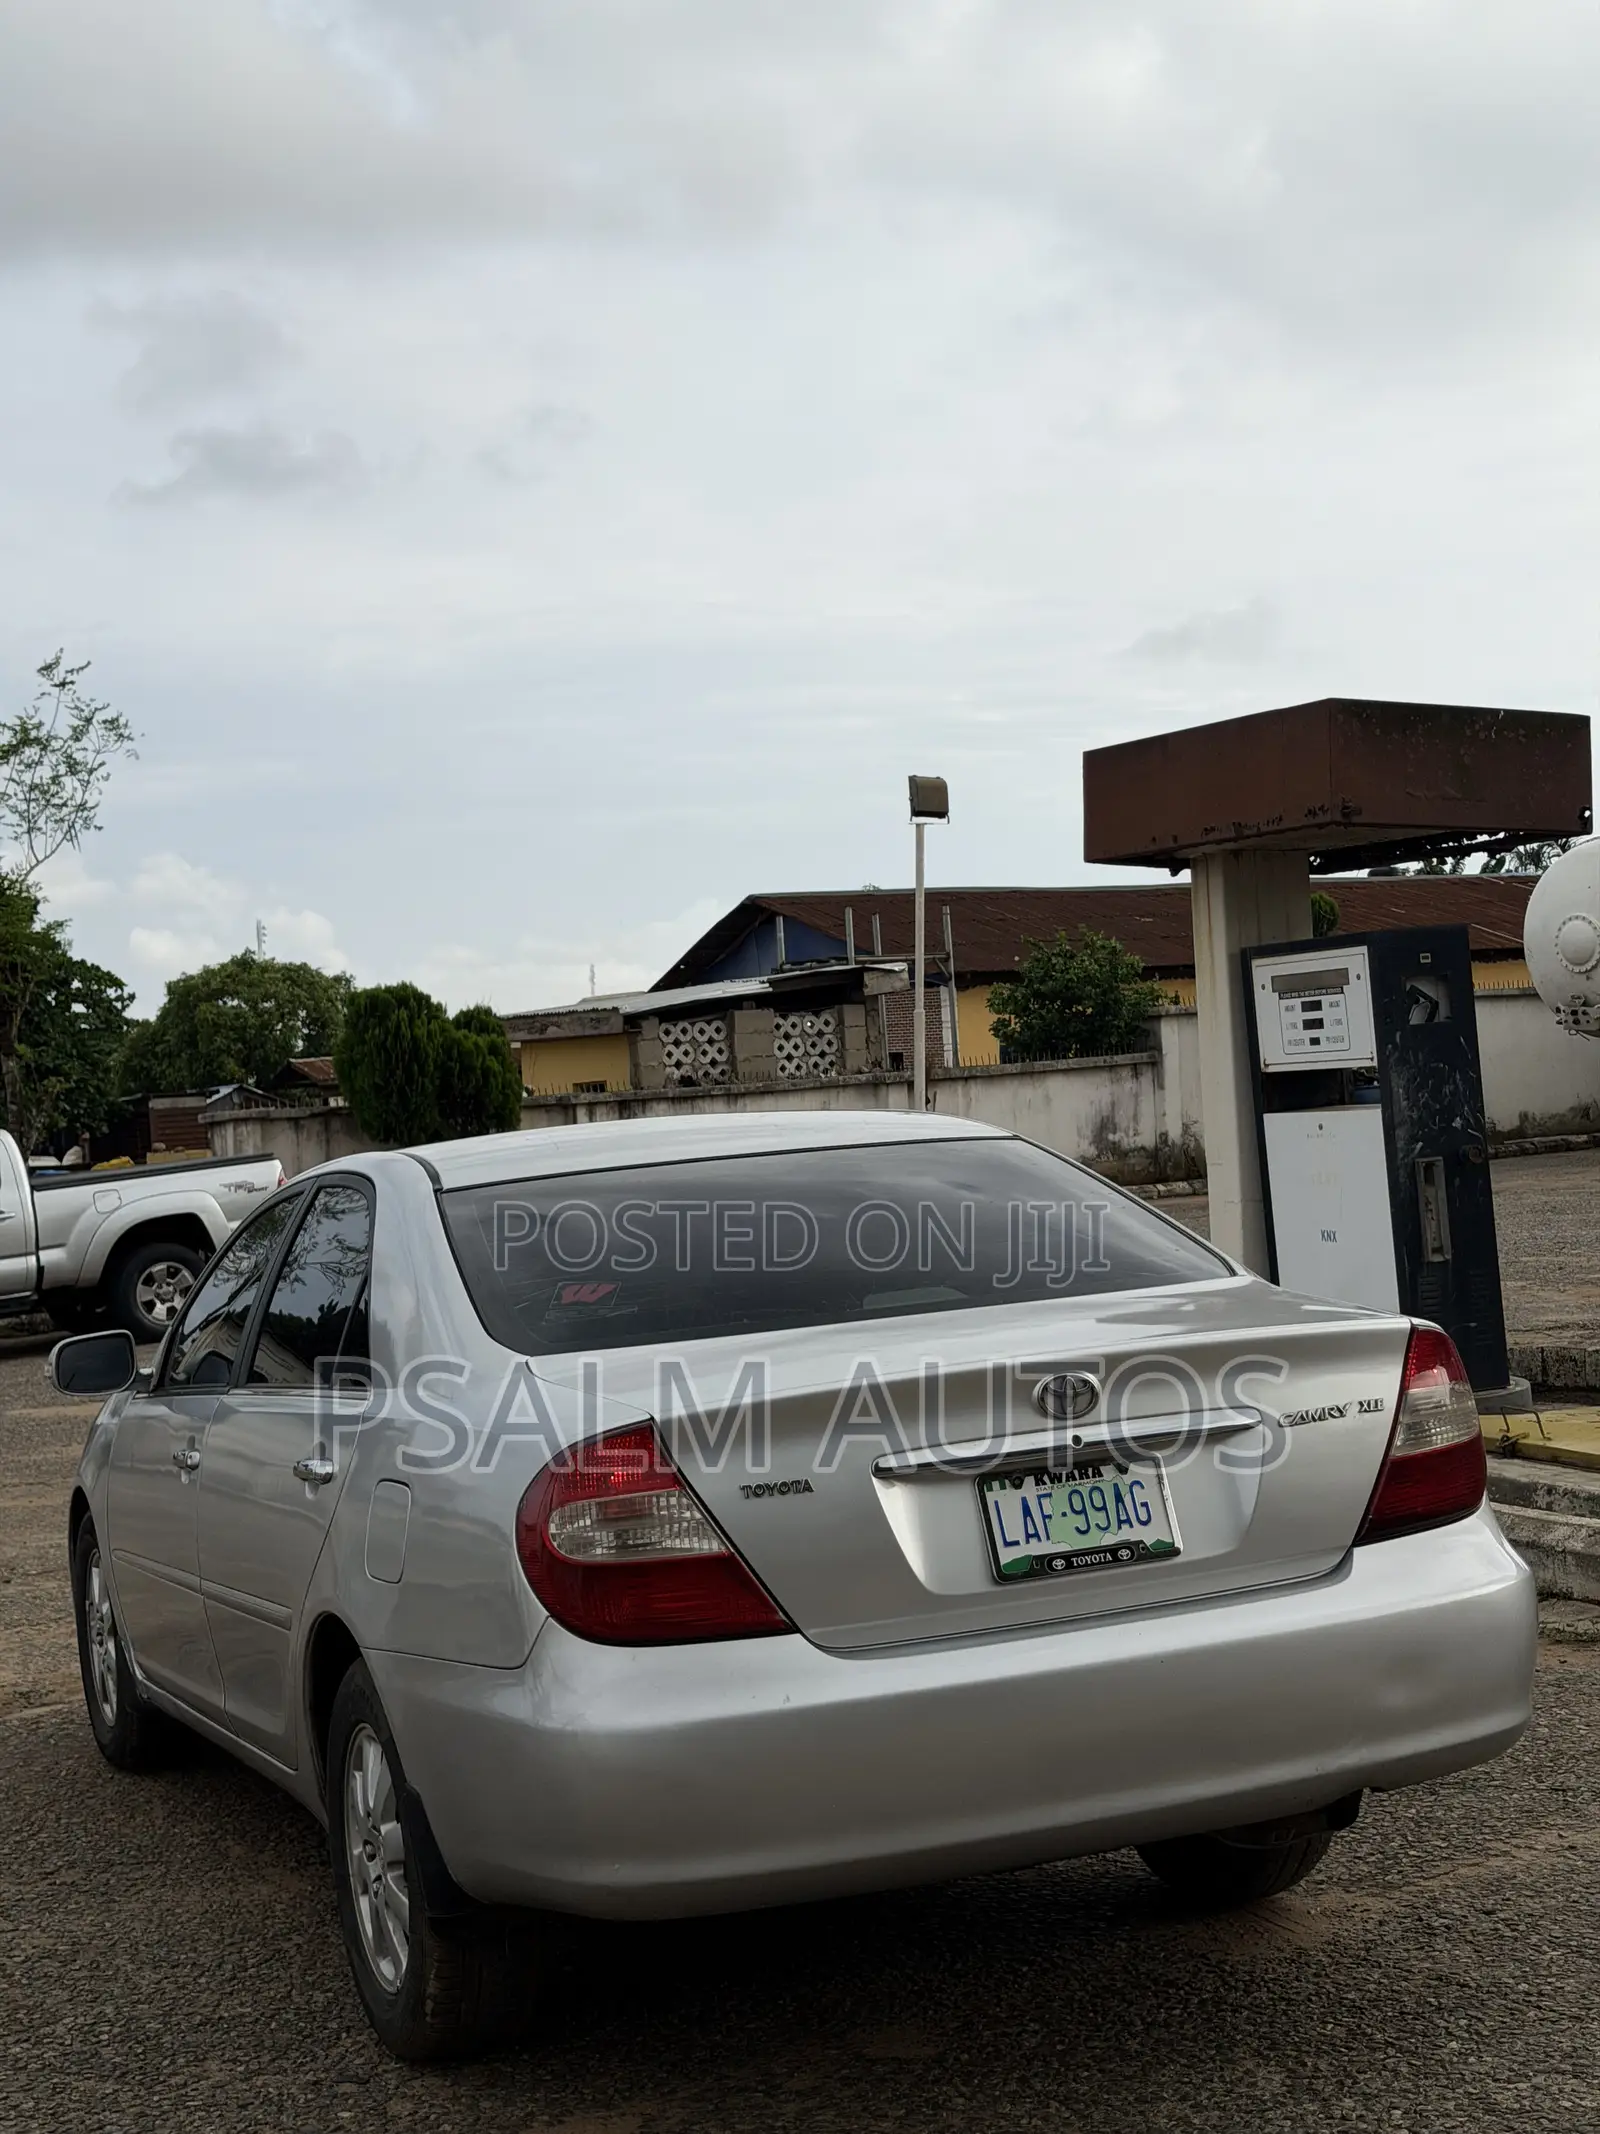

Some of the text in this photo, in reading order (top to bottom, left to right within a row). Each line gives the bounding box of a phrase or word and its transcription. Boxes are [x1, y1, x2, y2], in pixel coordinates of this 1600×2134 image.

[1278, 1398, 1384, 1428] CAMRY XLE
[1034, 1466, 1105, 1487] KWARA
[740, 1478, 815, 1499] TOYOTA
[1070, 1552, 1113, 1567] TOYOTA
